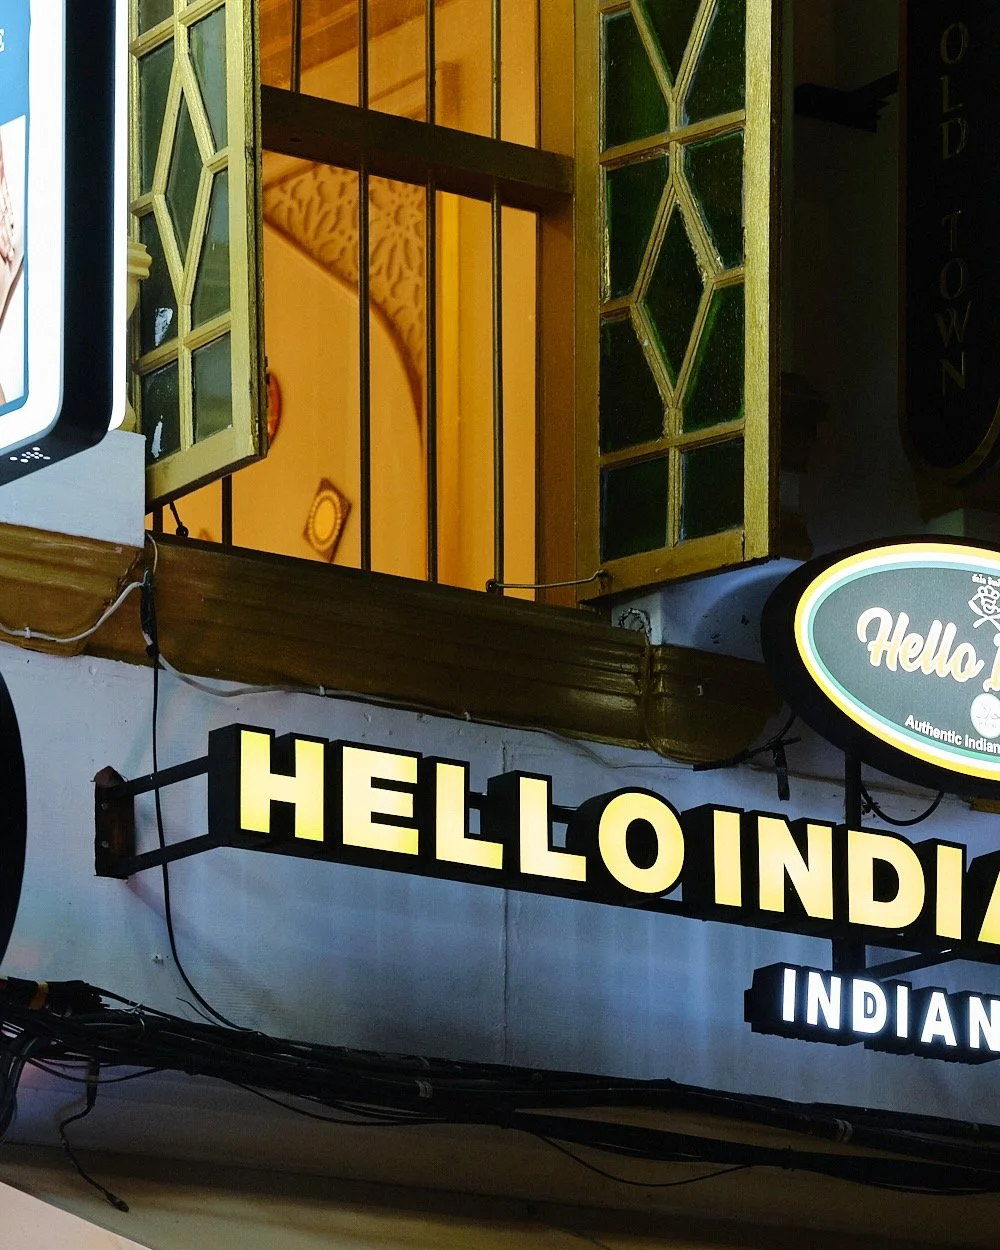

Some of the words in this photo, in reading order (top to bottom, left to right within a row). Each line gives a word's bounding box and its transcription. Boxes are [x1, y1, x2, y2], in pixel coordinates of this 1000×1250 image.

[939, 20, 971, 162] OLD
[934, 207, 974, 397] TOWN
[856, 606, 985, 683] Hello
[904, 713, 963, 747] Authentic
[239, 729, 686, 895] HELLO
